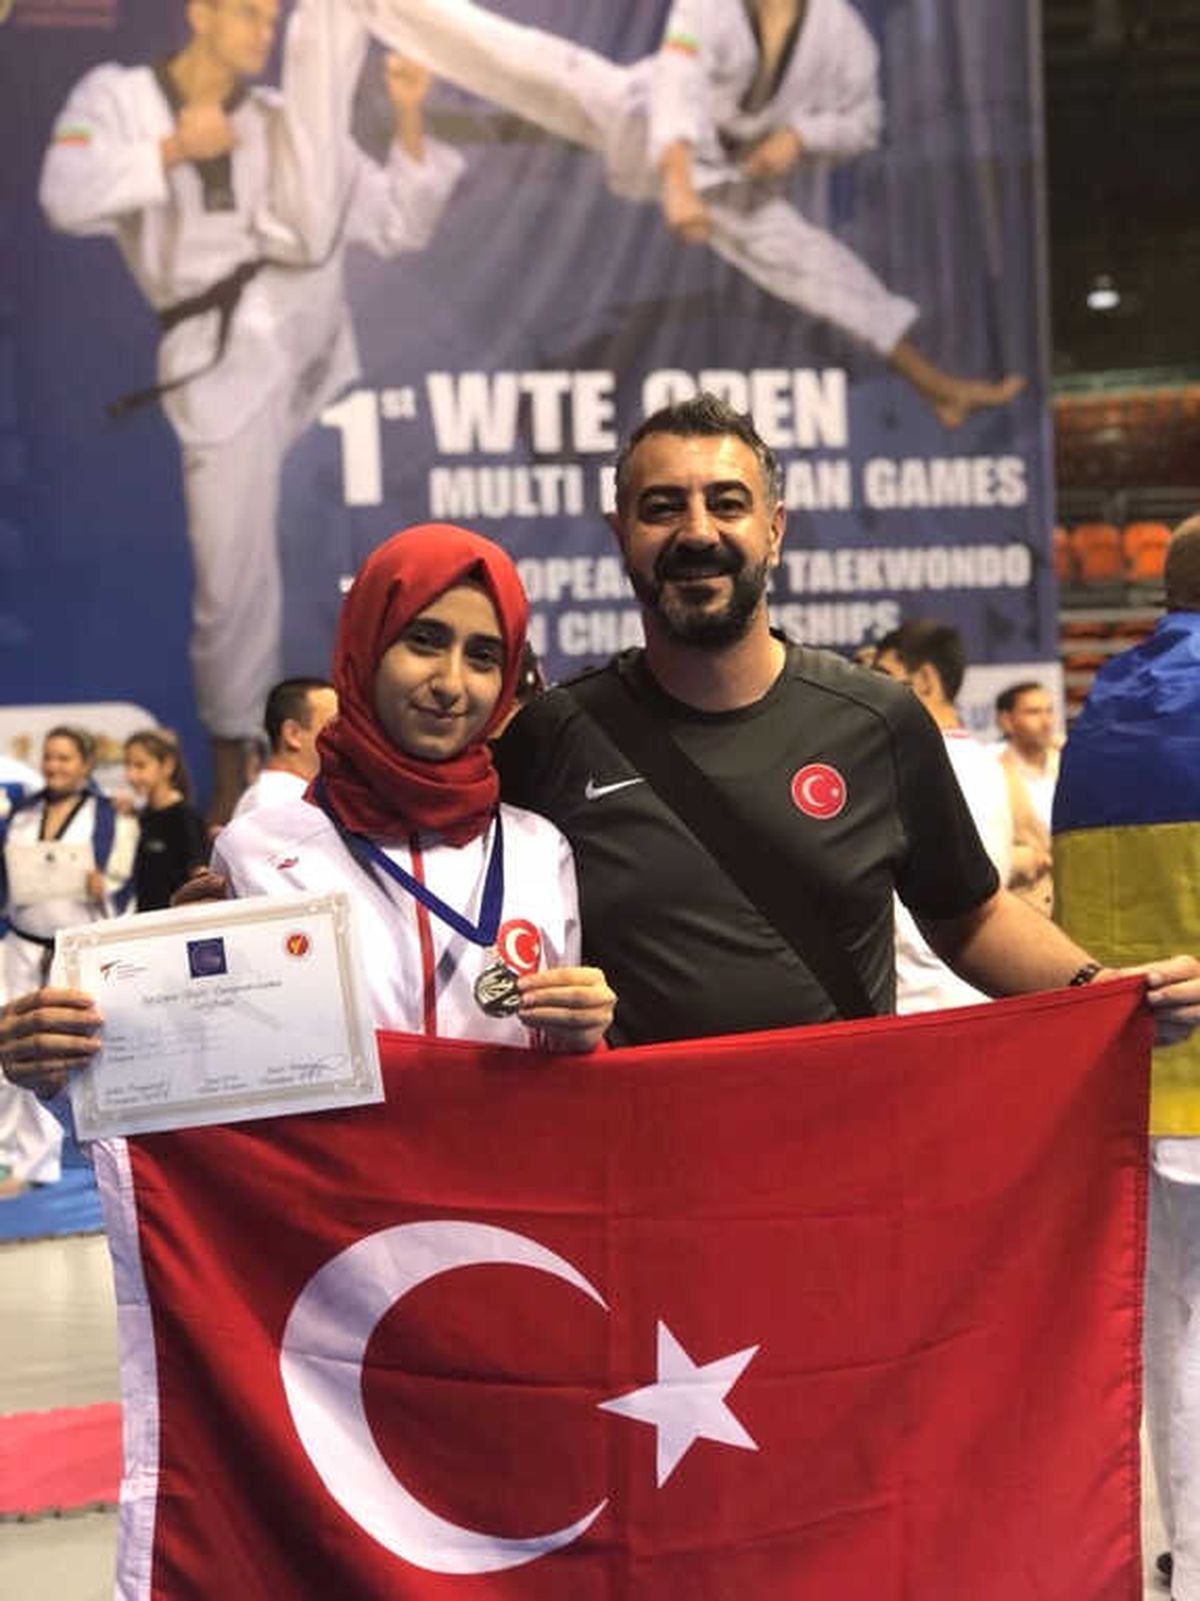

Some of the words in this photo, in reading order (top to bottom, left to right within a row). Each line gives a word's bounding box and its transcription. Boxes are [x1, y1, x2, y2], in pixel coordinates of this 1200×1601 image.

[426, 369, 617, 454] WTE
[429, 464, 583, 519] MULTI
[864, 455, 1027, 510] GAMES
[783, 543, 1031, 594] TAEKWONDO
